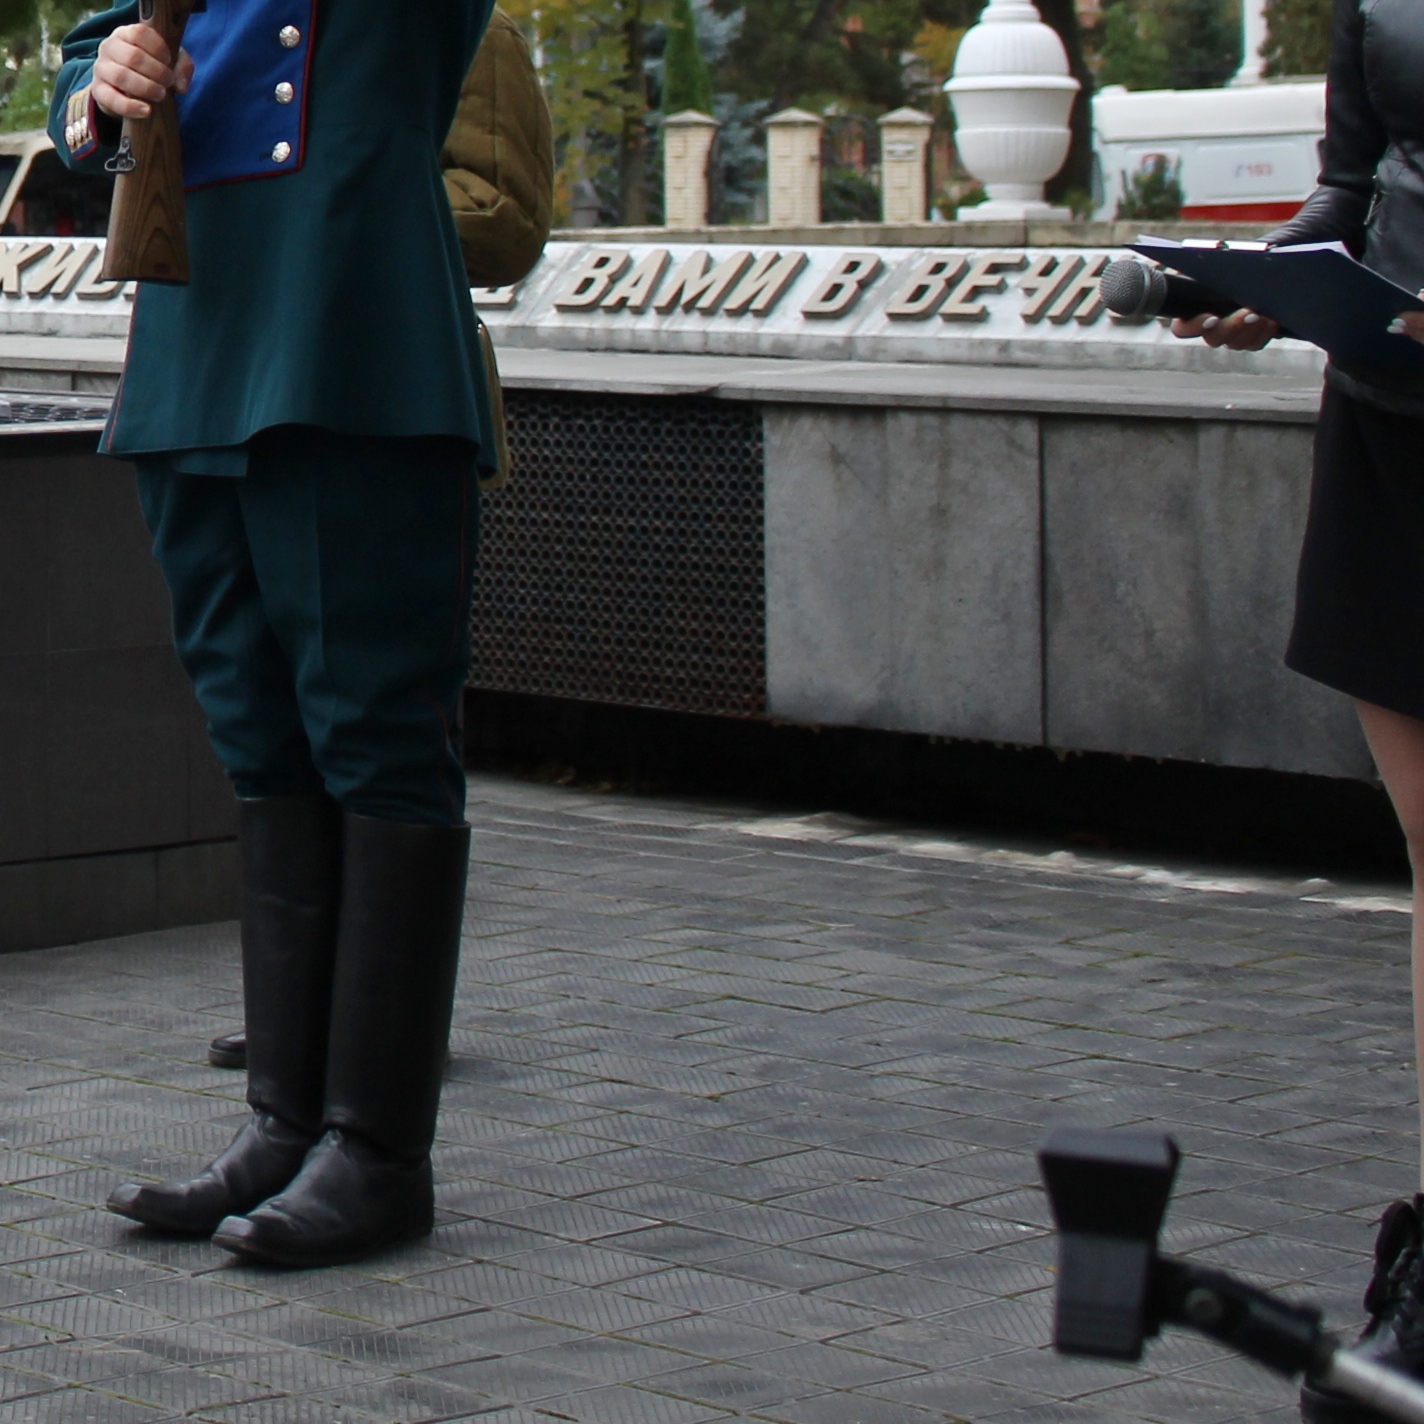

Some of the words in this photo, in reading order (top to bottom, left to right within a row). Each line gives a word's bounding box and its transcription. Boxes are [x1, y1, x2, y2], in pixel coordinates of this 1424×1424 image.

[554, 248, 809, 318] ВАМИ
[799, 252, 886, 320] В
[885, 253, 1172, 328] ВЕЧН
